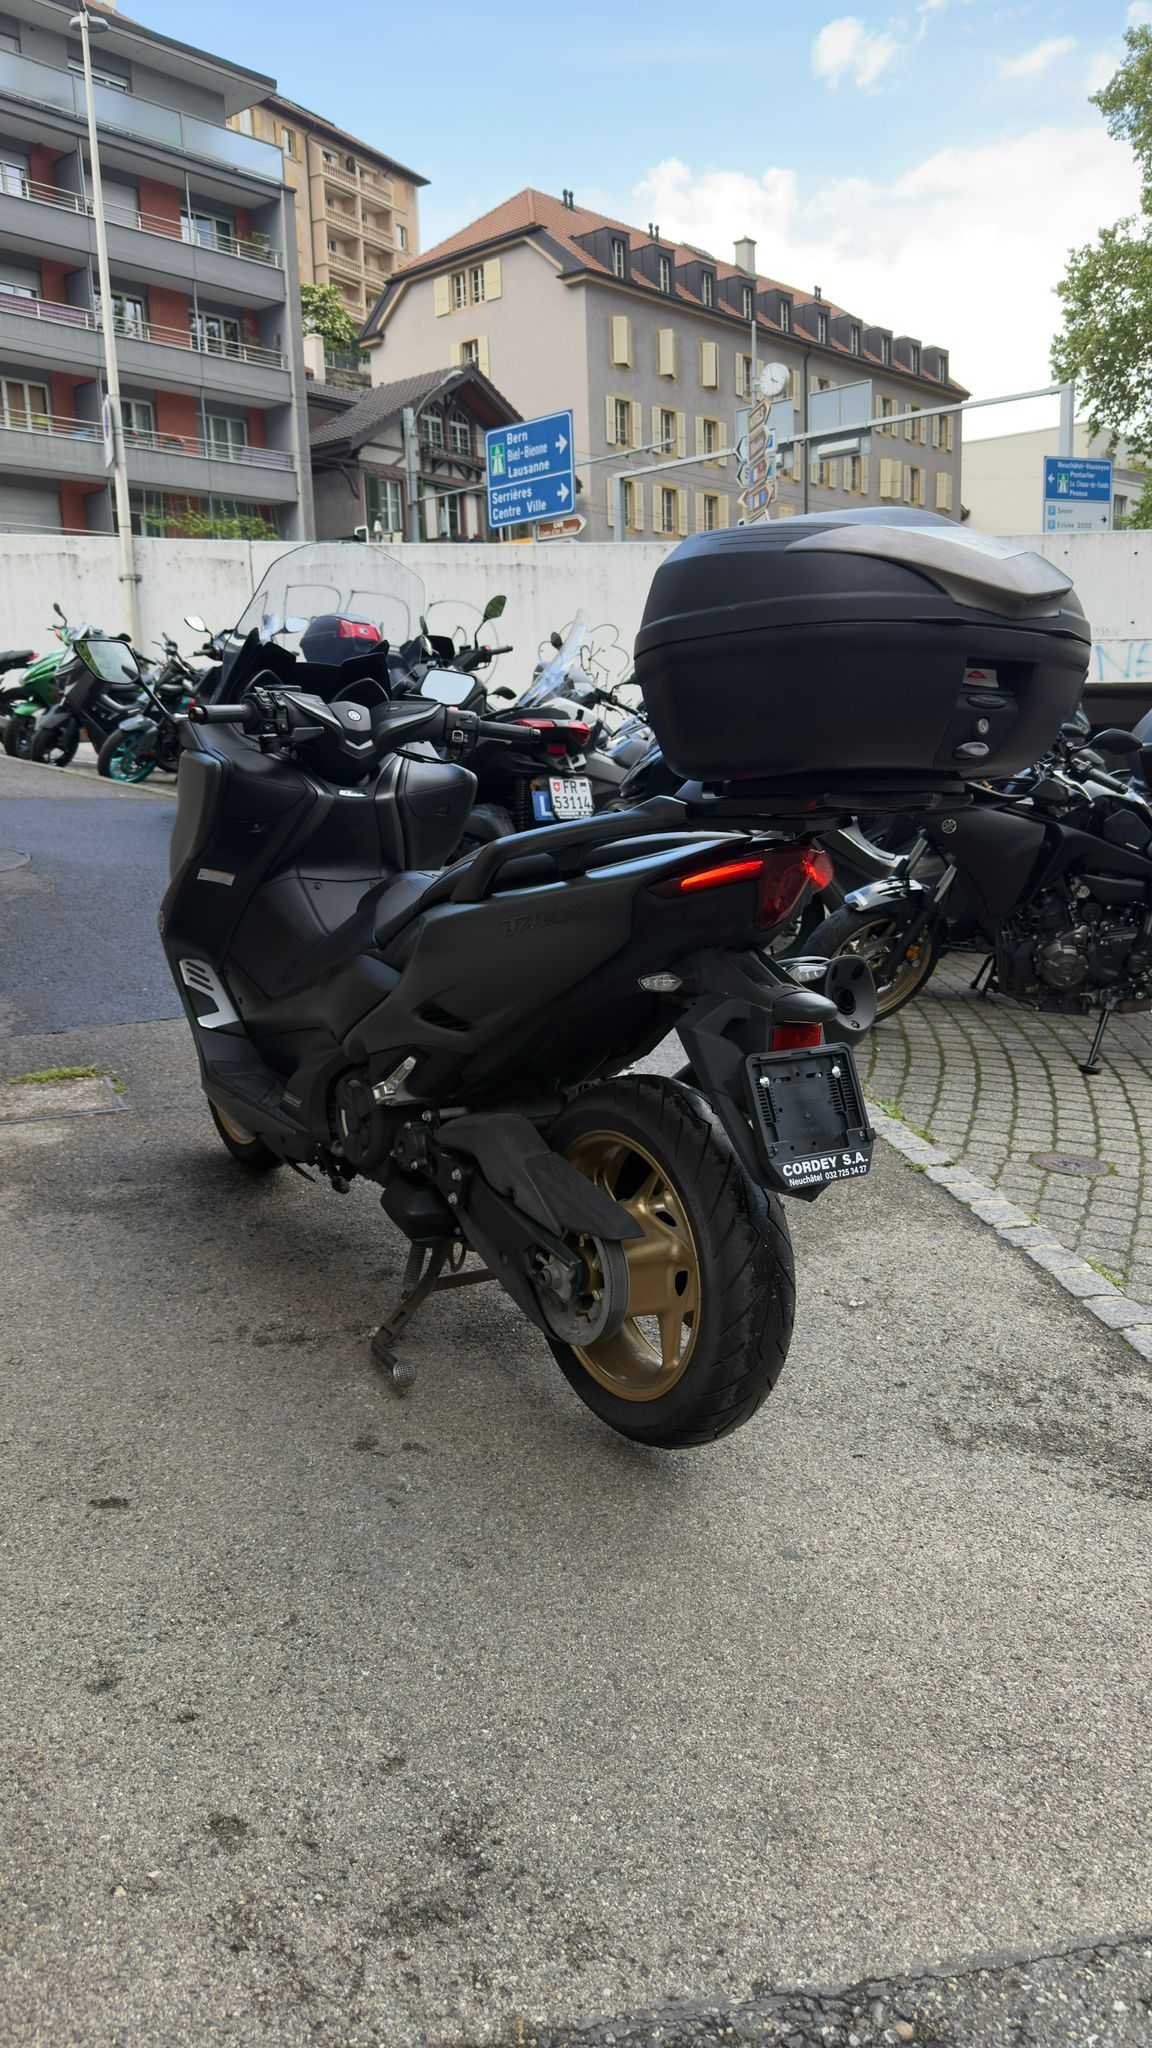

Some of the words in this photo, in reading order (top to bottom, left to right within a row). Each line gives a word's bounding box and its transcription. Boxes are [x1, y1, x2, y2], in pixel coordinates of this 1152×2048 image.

[506, 431, 528, 445] Bern
[507, 443, 548, 462] Biel-Bienne
[508, 460, 550, 478] Lausanne
[1069, 470, 1096, 478] Pontarlier
[492, 487, 532, 505] Serrières
[1069, 489, 1088, 497] Peseux
[492, 506, 521, 520] Centre
[527, 499, 547, 513] Ville
[1057, 507, 1073, 515] Seyon
[563, 780, 577, 793] FR
[539, 795, 554, 816] L
[555, 796, 591, 809] 53114
[782, 1156, 837, 1177] CORDEY
[842, 1151, 868, 1166] S.A.
[789, 1173, 823, 1187] Neuchâtel
[825, 1171, 838, 1180] 032
[838, 1168, 850, 1177] 725
[851, 1166, 859, 1175] 34
[859, 1164, 867, 1173] 27
